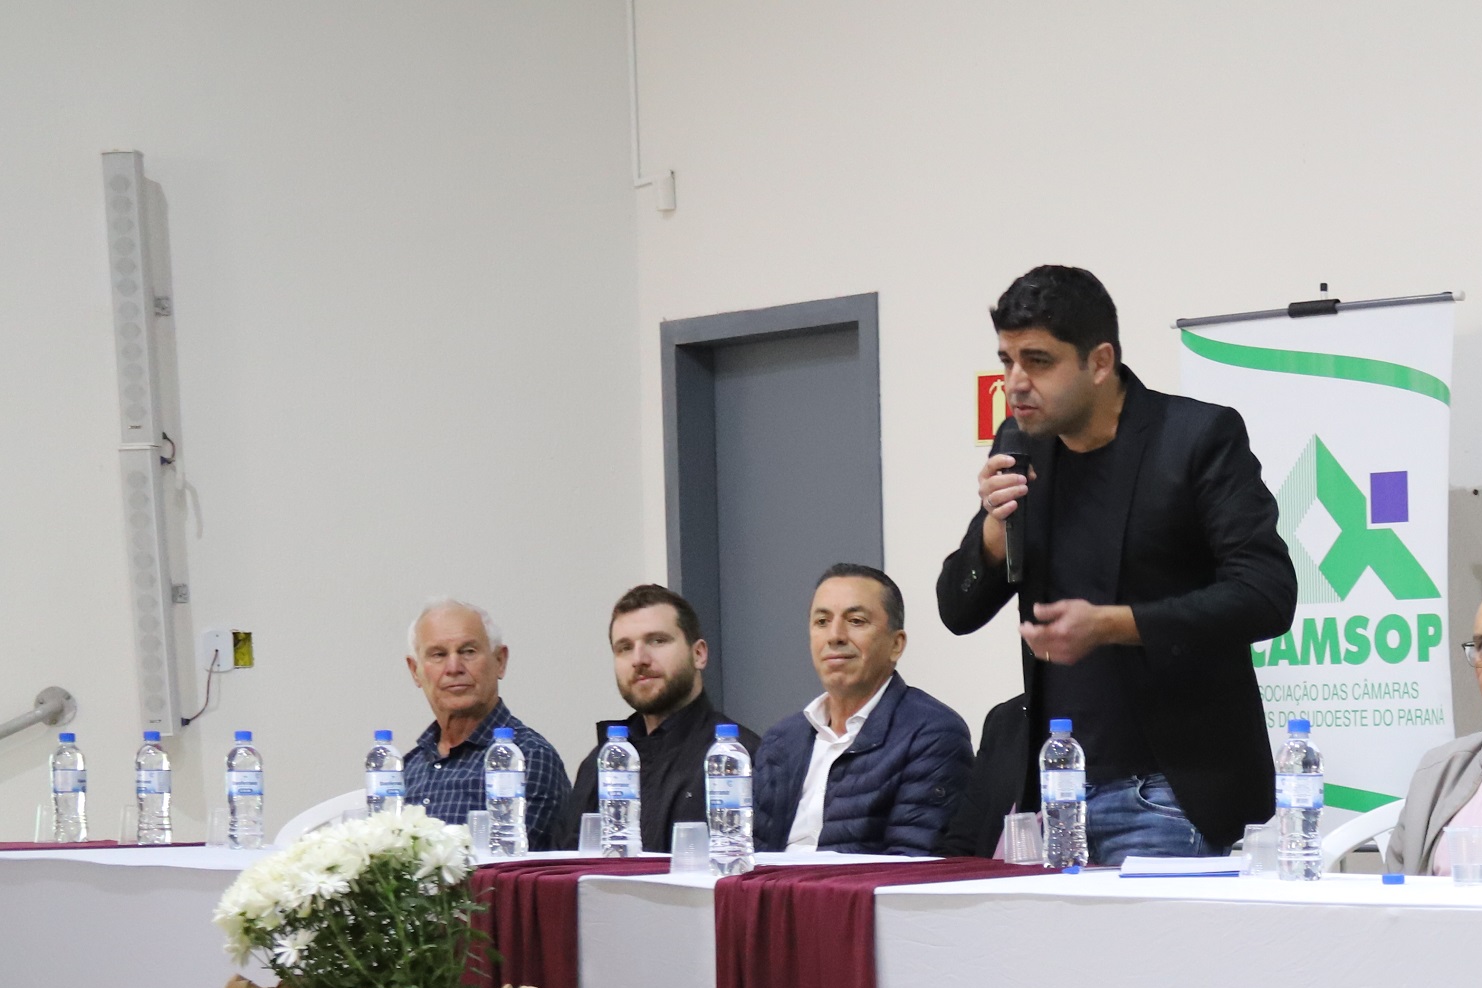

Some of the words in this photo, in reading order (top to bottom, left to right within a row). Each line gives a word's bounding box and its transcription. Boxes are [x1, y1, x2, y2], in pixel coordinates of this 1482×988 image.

[1322, 683, 1348, 701] DAS
[1352, 678, 1419, 701] CÂMARAS
[1373, 708, 1394, 727] DO
[1398, 704, 1445, 726] PARANÁ
